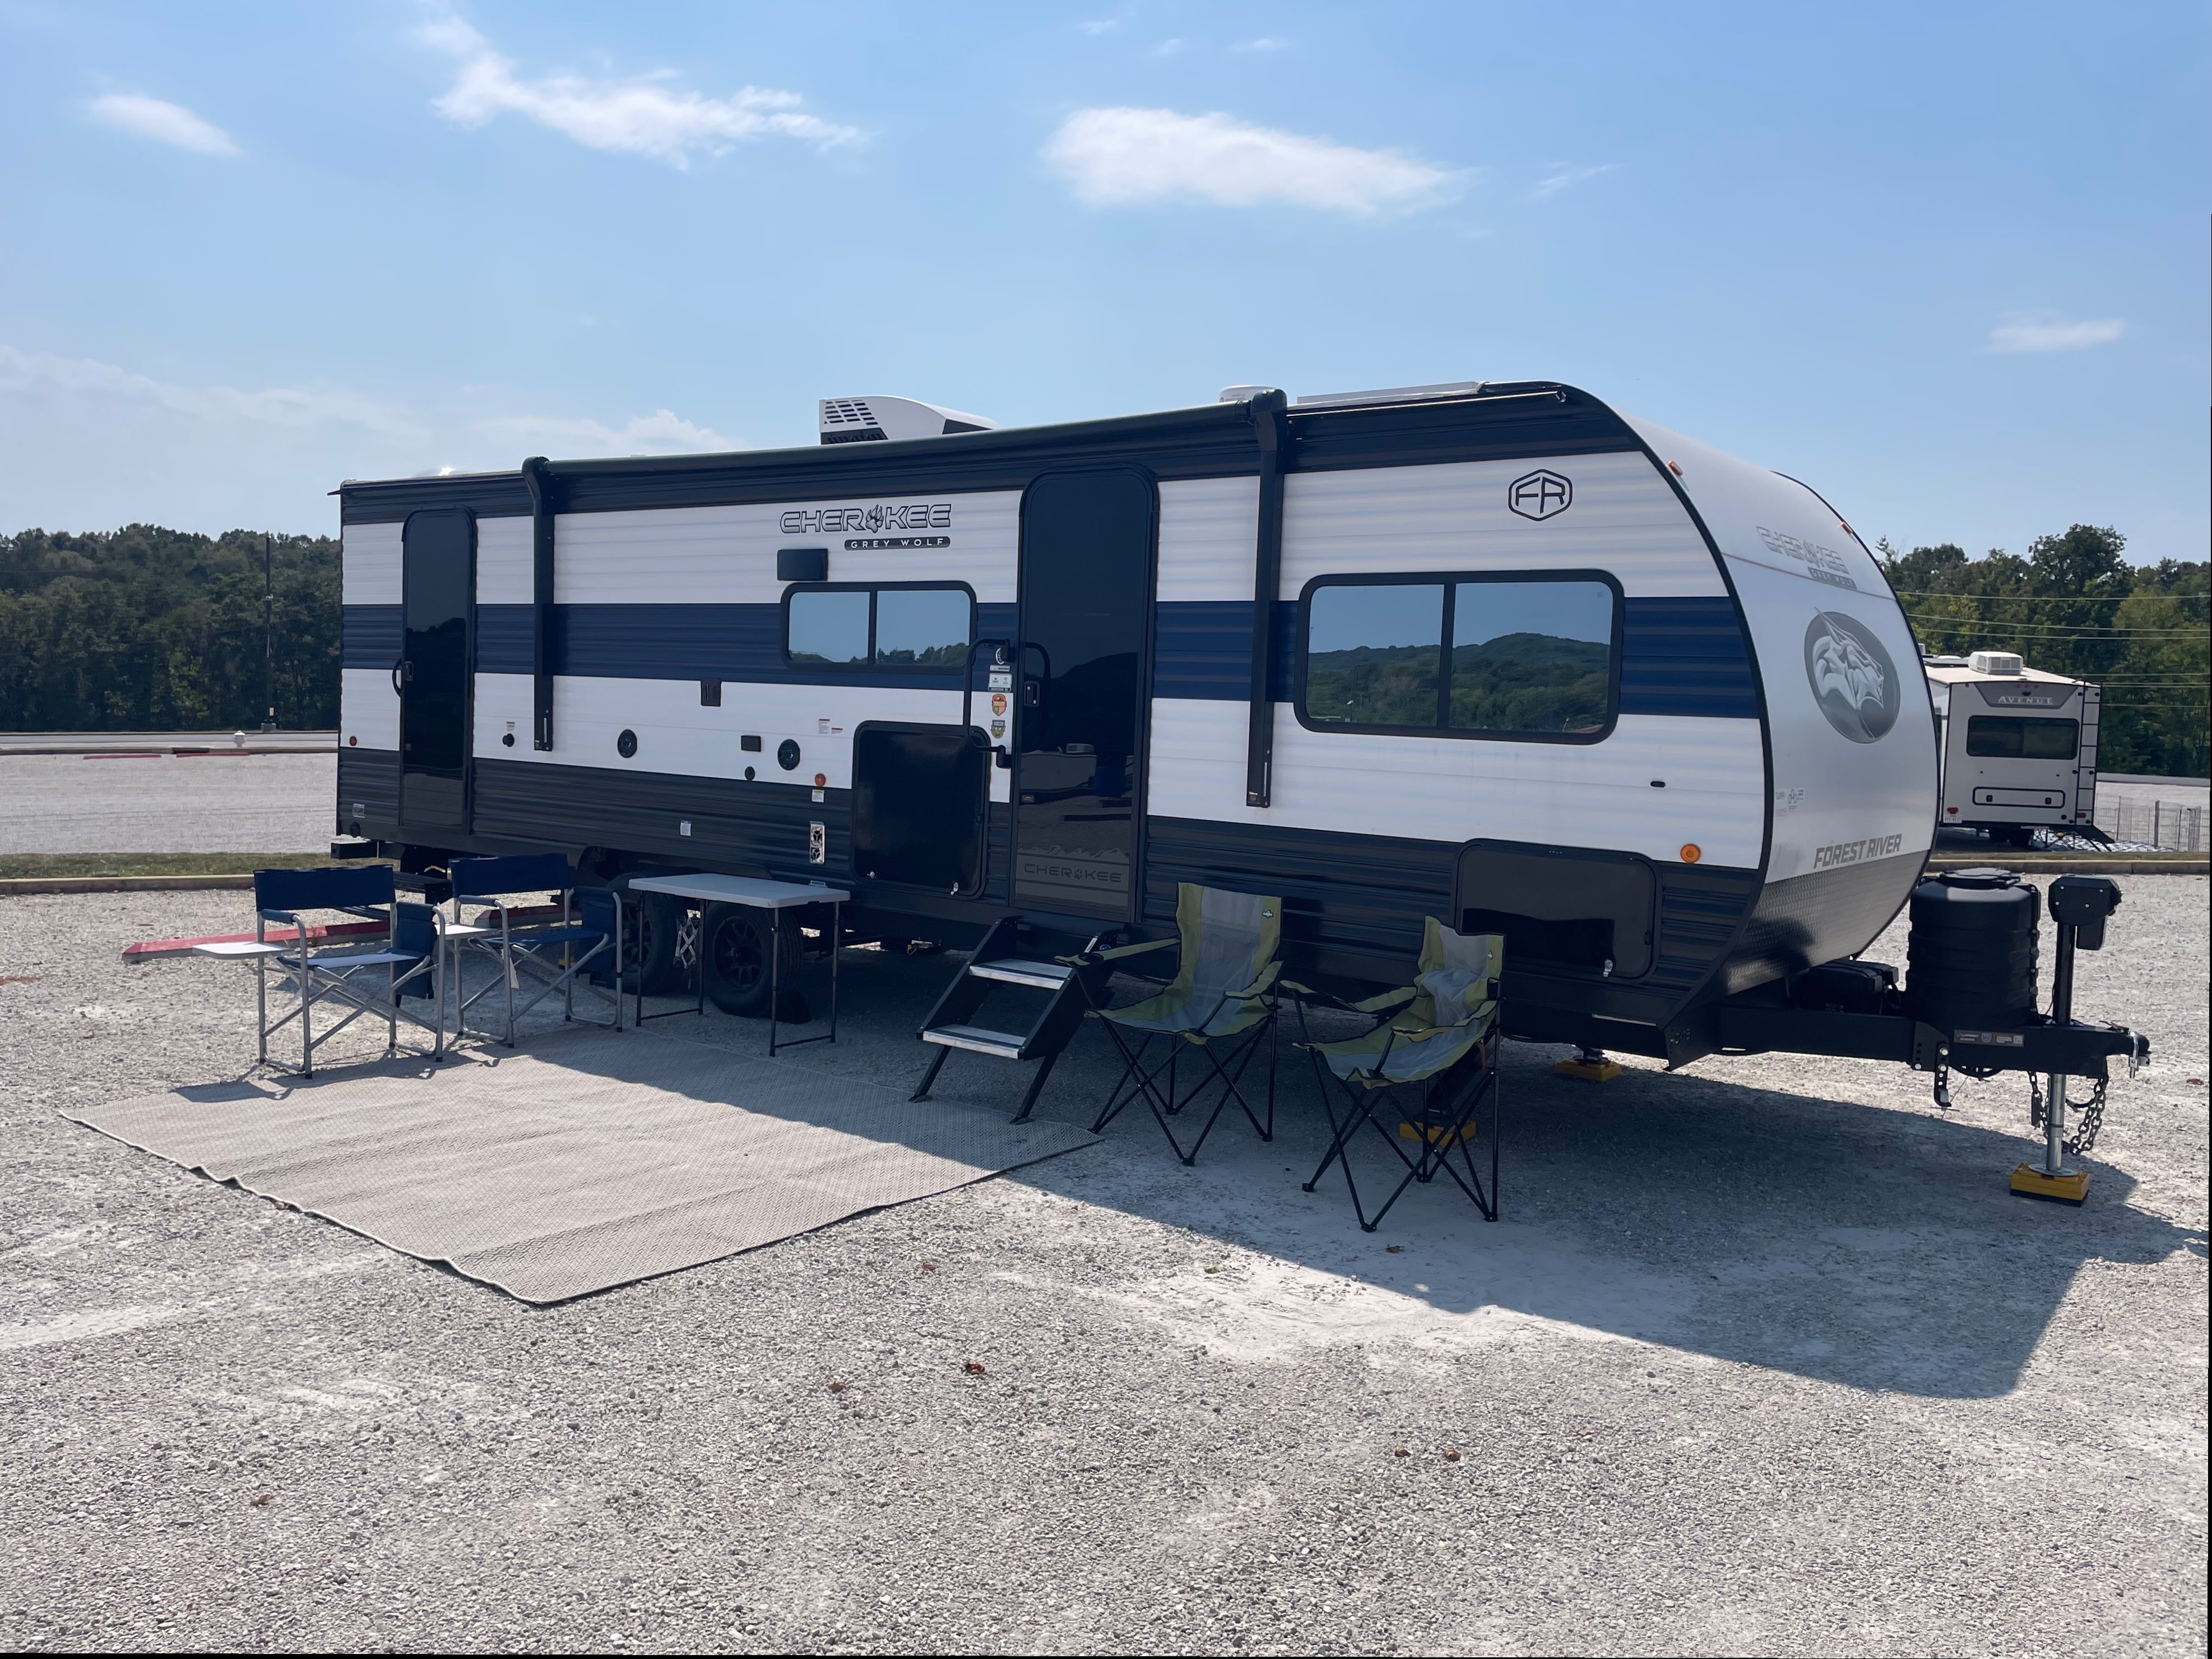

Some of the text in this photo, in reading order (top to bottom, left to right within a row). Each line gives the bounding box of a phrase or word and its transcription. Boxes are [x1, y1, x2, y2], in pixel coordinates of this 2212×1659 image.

[850, 537, 945, 549] GREY WOLF
[1998, 696, 2053, 706] AVENUE
[1814, 833, 1903, 869] FOREST RIVER
